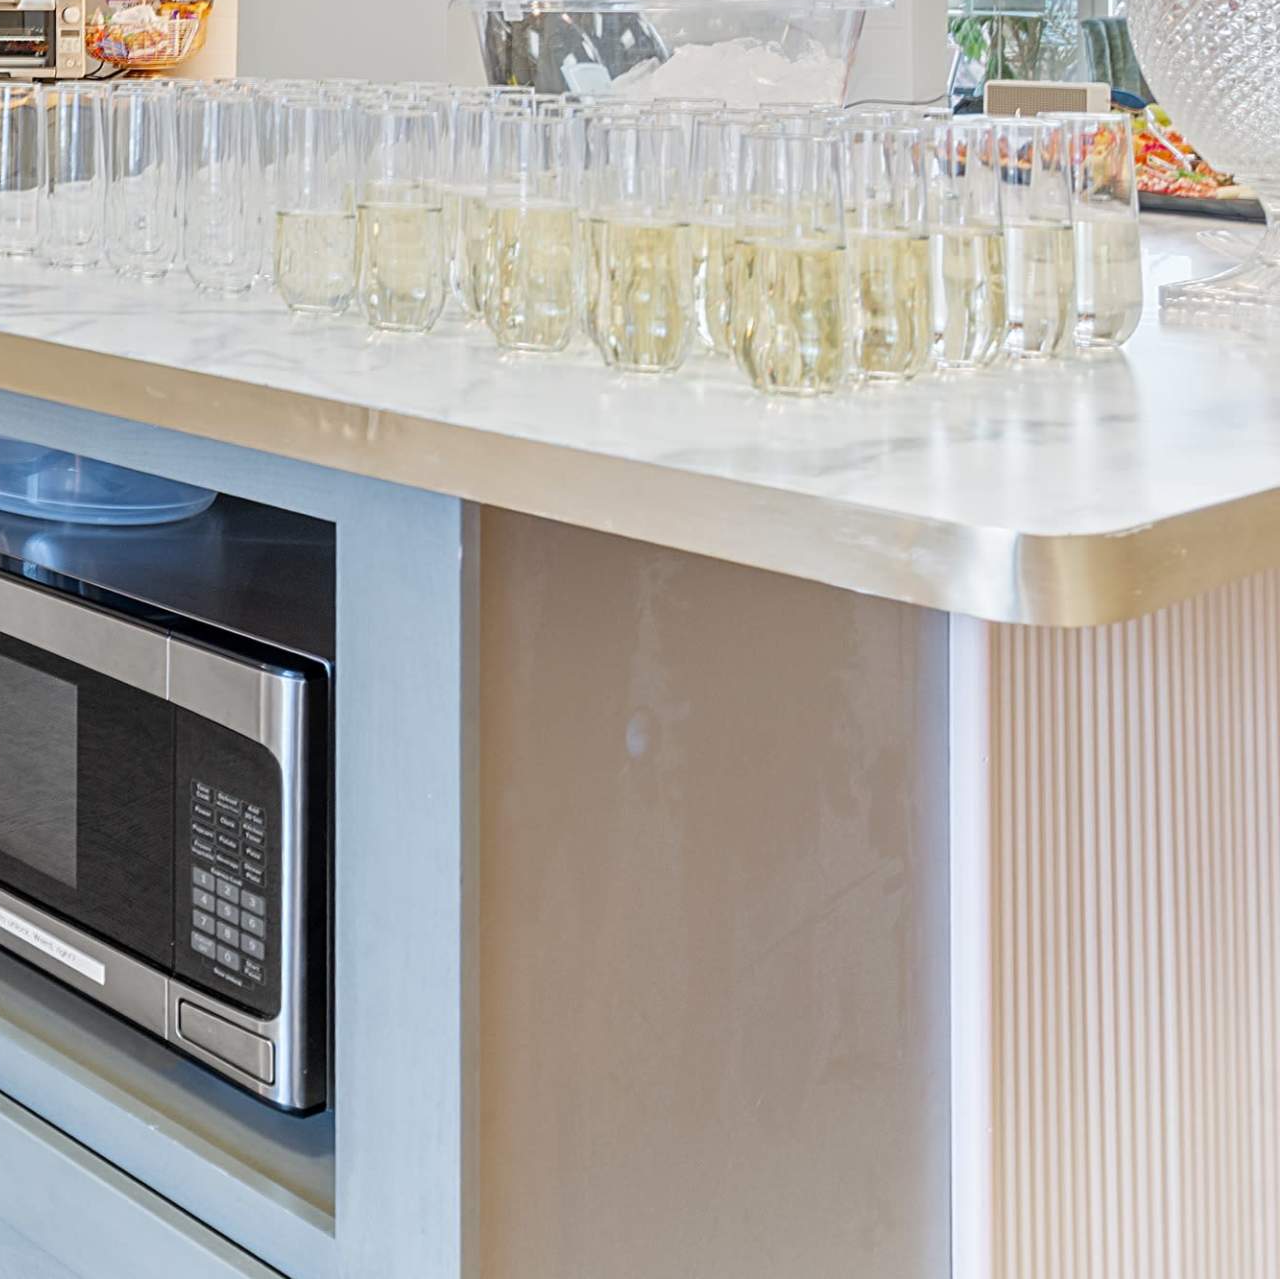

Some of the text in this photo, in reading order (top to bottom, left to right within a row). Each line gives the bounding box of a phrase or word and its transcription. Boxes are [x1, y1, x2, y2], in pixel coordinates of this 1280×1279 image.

[201, 874, 207, 884] 1
[224, 886, 231, 896] 2
[201, 894, 208, 904] 4
[249, 897, 256, 907] 3
[224, 905, 231, 916] 5
[201, 916, 207, 926] 7
[249, 918, 256, 929] 6
[224, 927, 231, 939] 8
[249, 941, 256, 951] 9
[224, 951, 231, 962] 0
